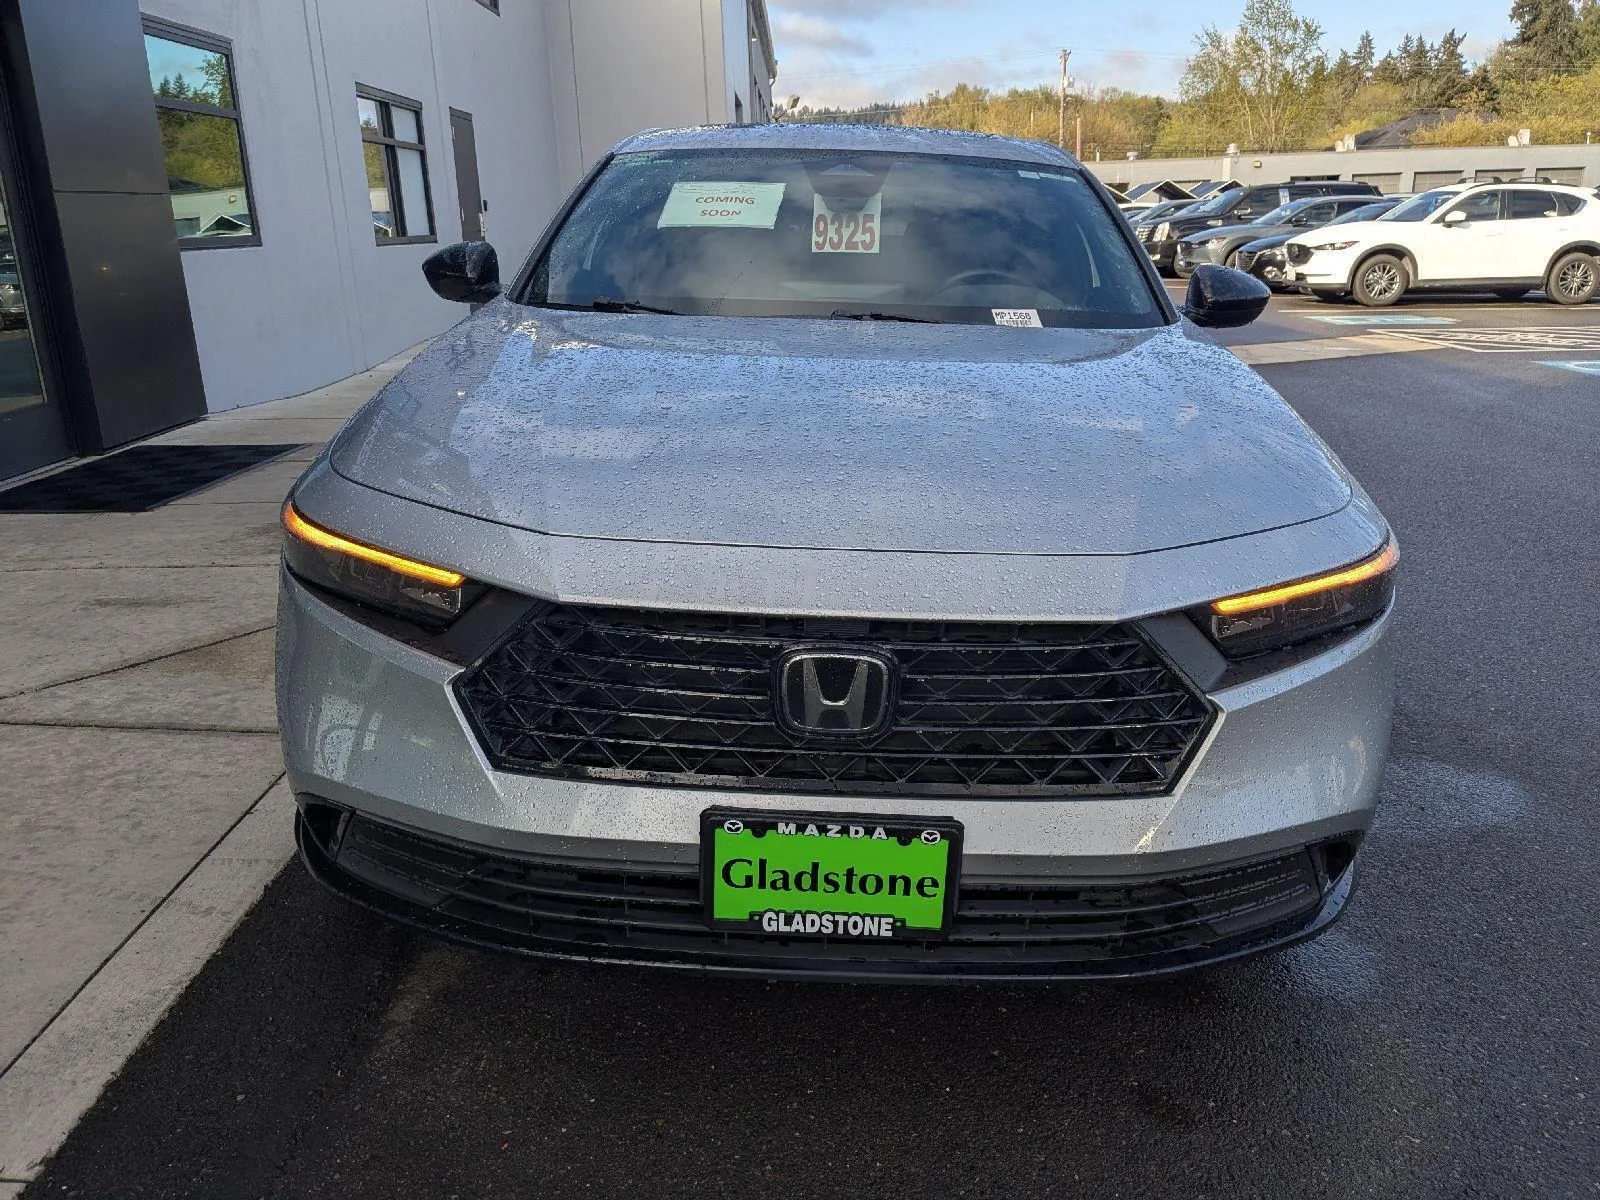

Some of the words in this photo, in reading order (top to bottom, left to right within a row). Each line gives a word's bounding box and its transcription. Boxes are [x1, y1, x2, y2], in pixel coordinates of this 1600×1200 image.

[695, 196, 755, 205] COMING
[699, 209, 742, 217] SOON
[814, 213, 876, 251] 9325
[994, 311, 1032, 320] MP1568
[777, 822, 888, 840] MAZDA
[721, 857, 941, 899] Gladstone
[762, 911, 894, 937] GLADSTONE
